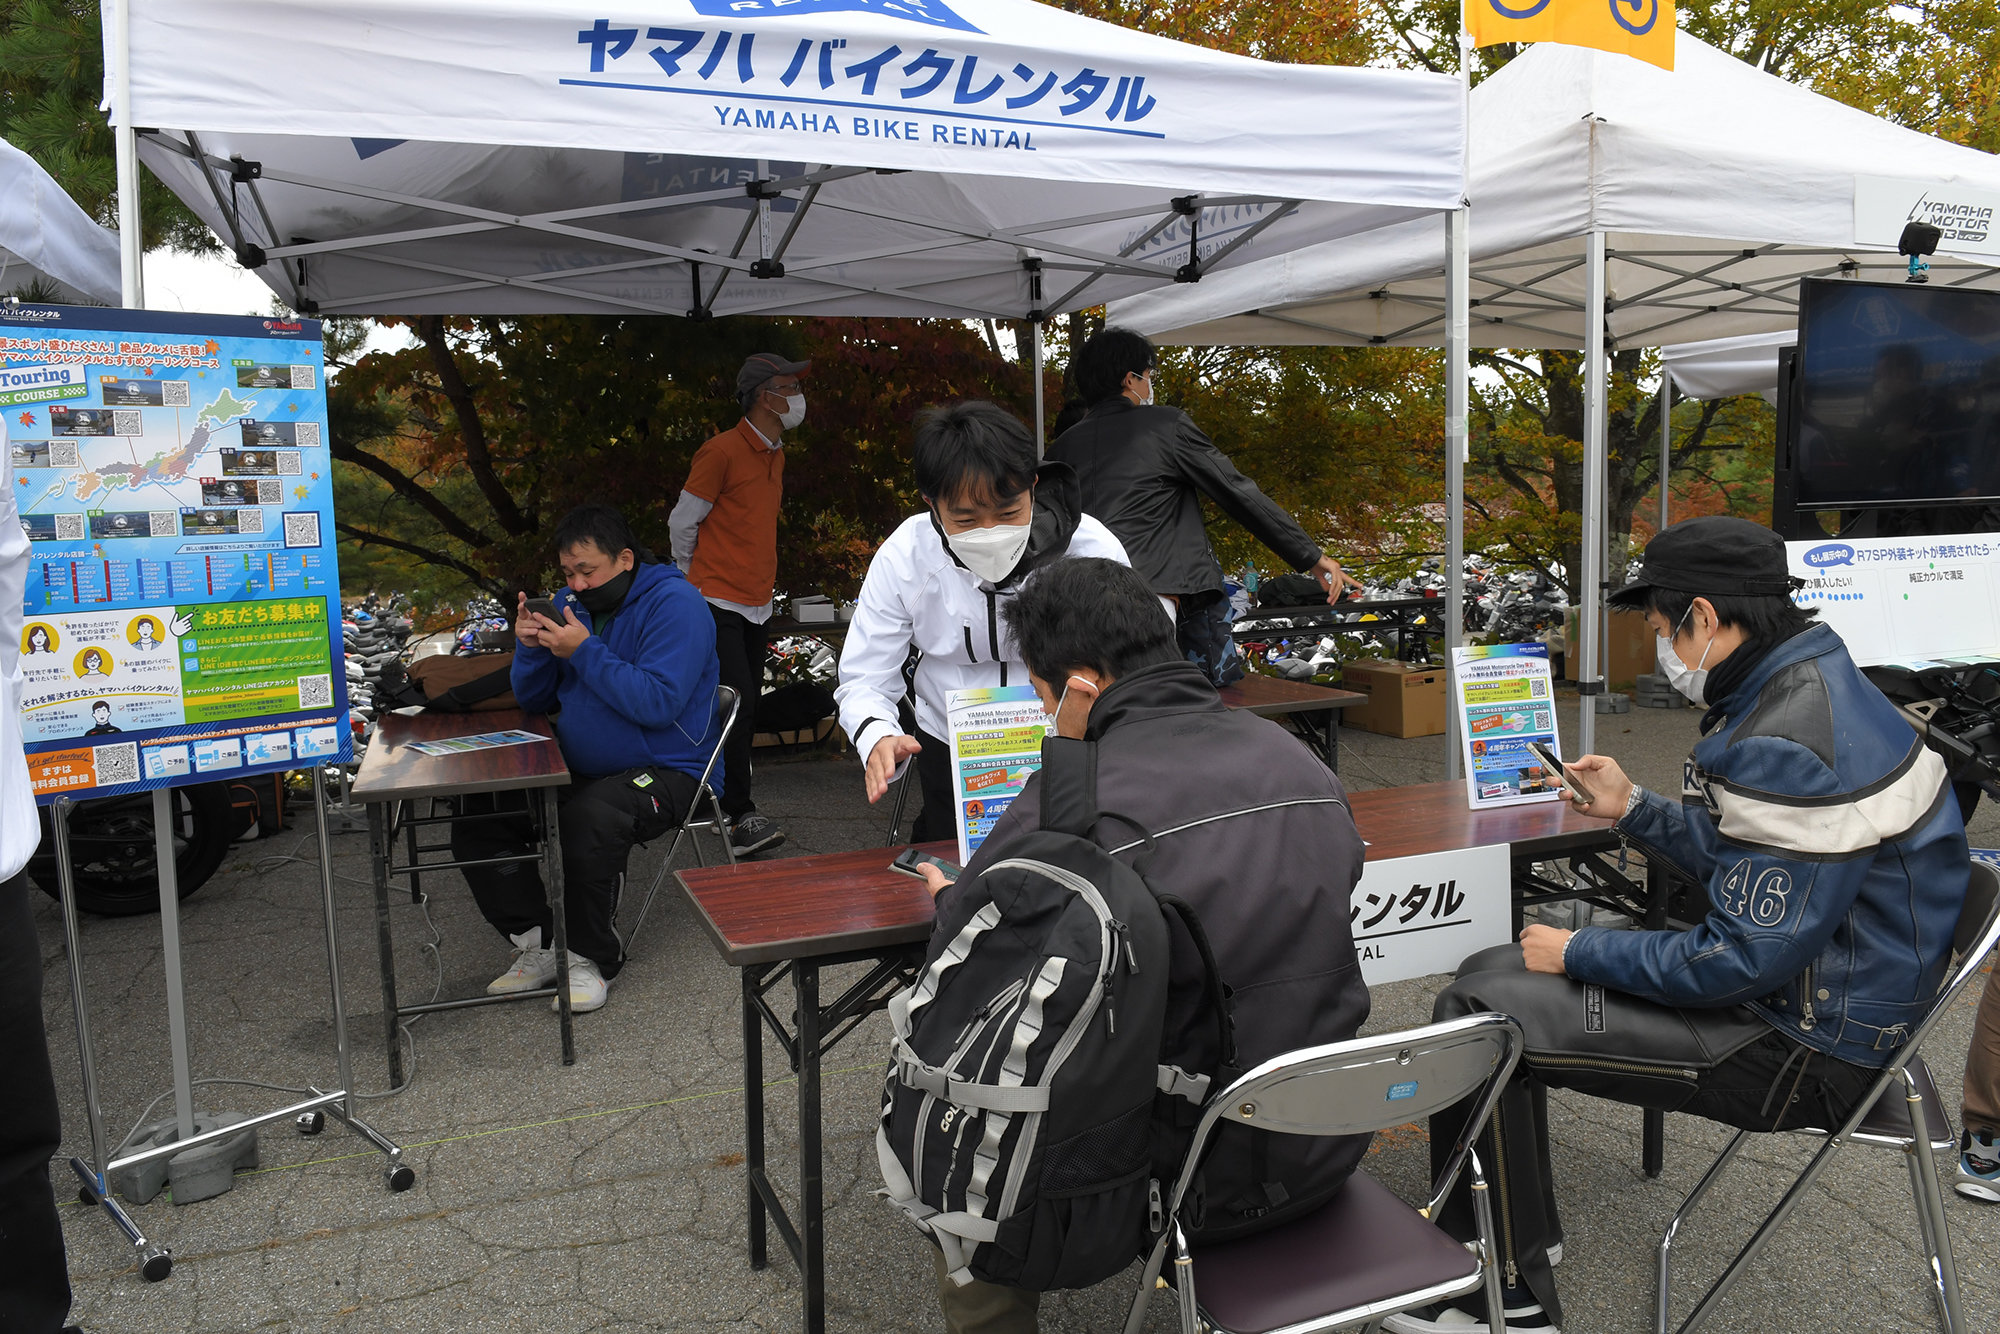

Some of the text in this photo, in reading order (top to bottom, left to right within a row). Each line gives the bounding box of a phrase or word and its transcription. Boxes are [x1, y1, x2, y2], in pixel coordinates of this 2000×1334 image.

[578, 19, 1157, 122] ヤマハ バイクレンタル
[714, 105, 1038, 152] YAMAHA BIKE RENTAL
[1922, 201, 1993, 218] YAMAHA
[1930, 215, 1989, 230] MOTOR
[11, 309, 60, 318] バイクレンタル
[1, 368, 71, 387] Touring
[13, 389, 60, 403] COURSE
[1909, 570, 1964, 584] 純正カウルで満足
[203, 602, 320, 626] お友だち募集中
[967, 710, 994, 718] YAMAHA
[995, 708, 1027, 717] Motorcycle
[1028, 707, 1039, 715] Day
[42, 765, 72, 777] まずは
[1721, 858, 1793, 927] 46
